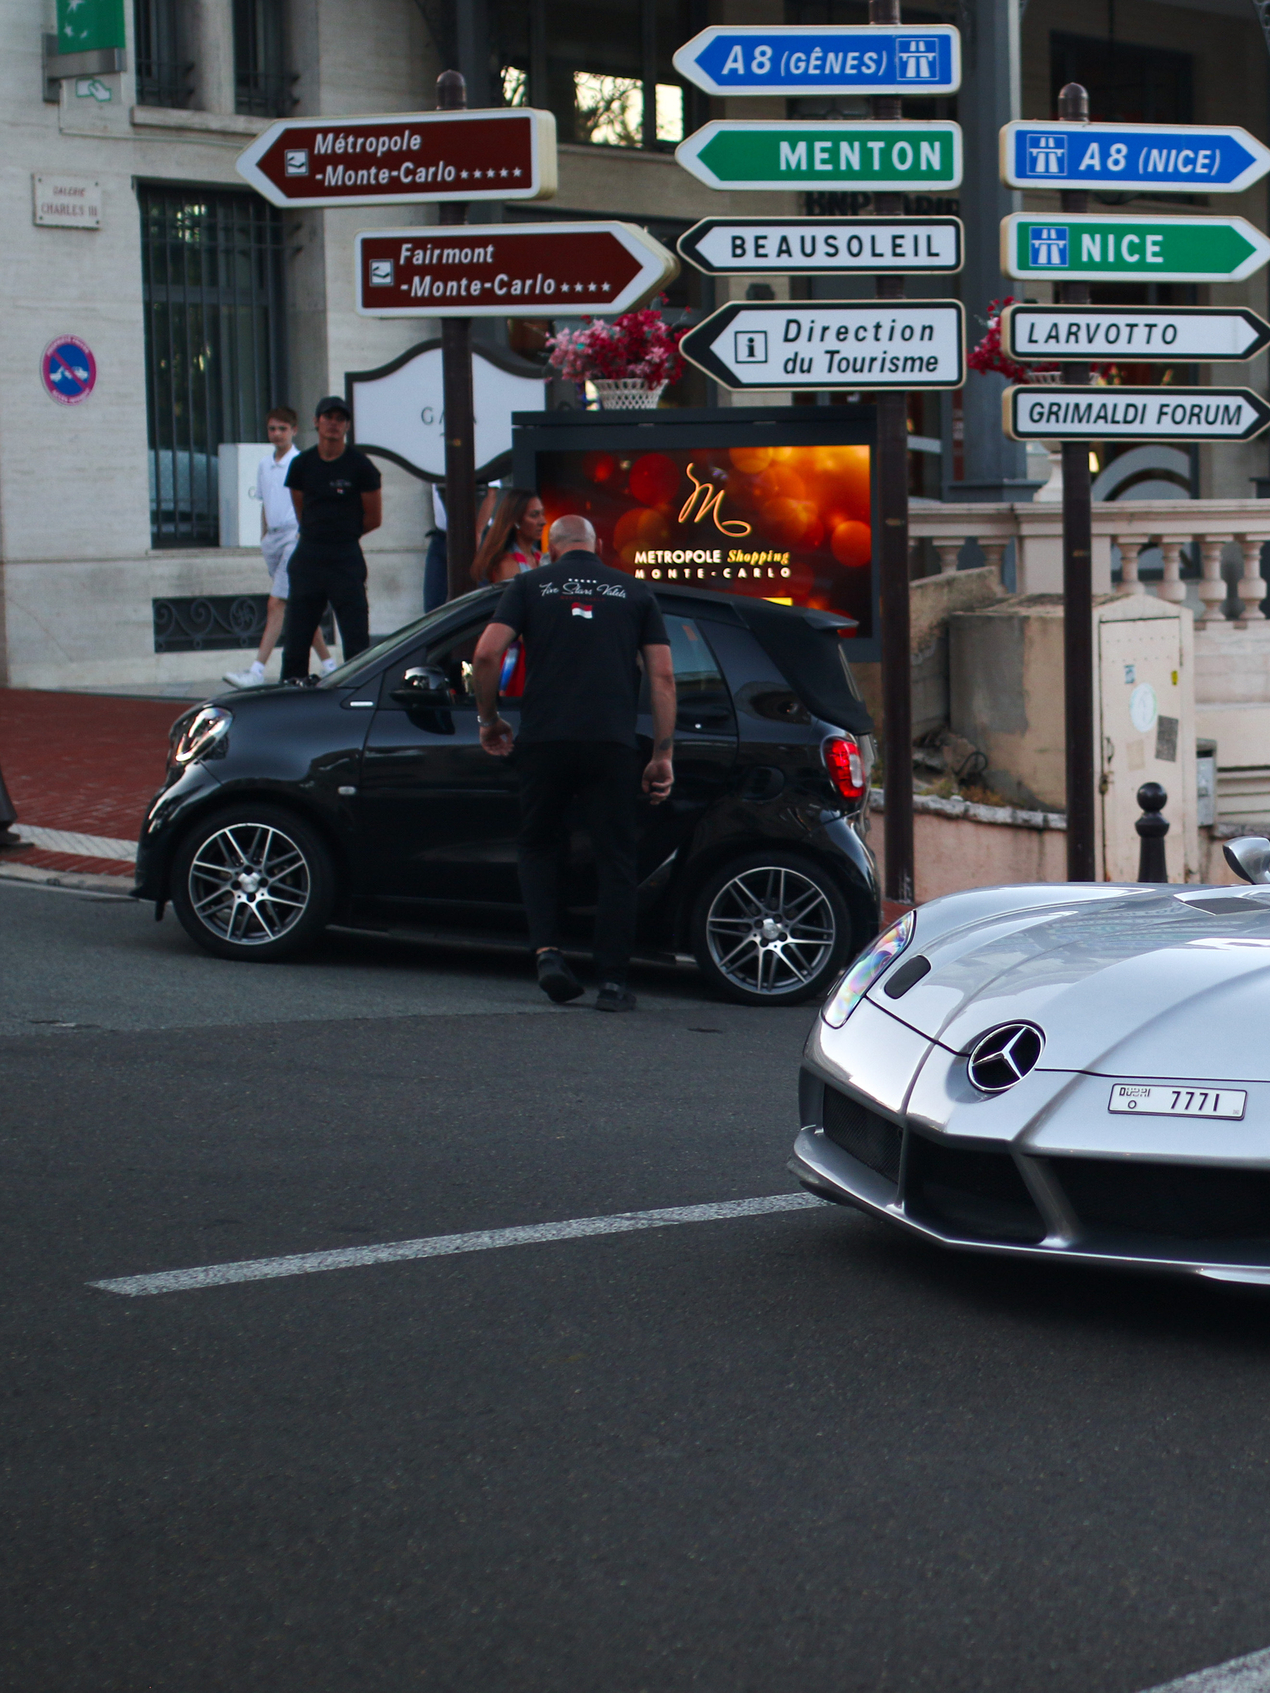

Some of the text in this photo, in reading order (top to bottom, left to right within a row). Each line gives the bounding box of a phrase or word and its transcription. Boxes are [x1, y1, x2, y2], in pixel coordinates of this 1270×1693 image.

[721, 44, 887, 77] A8 (GÊNES)
[314, 130, 422, 157] Métropole
[779, 140, 941, 171] MENTON
[1078, 142, 1221, 176] A8 (NICE)
[315, 161, 456, 187] -Monte-Carlo
[41, 202, 84, 216] CHARLES
[400, 244, 494, 266] Fairmont
[731, 234, 940, 258] BEAUSOLEIL
[1081, 233, 1164, 263] NICE
[400, 273, 556, 298] -Monte-Carlo
[783, 318, 934, 343] Direction
[1027, 322, 1178, 345] LARVOTTO
[783, 350, 938, 374] du Tourisme
[1028, 401, 1243, 426] GRIMALDI FORUM
[634, 549, 790, 566] METROPOLE Shopping
[562, 582, 592, 595] Stars
[1170, 1090, 1220, 1113] 7771
